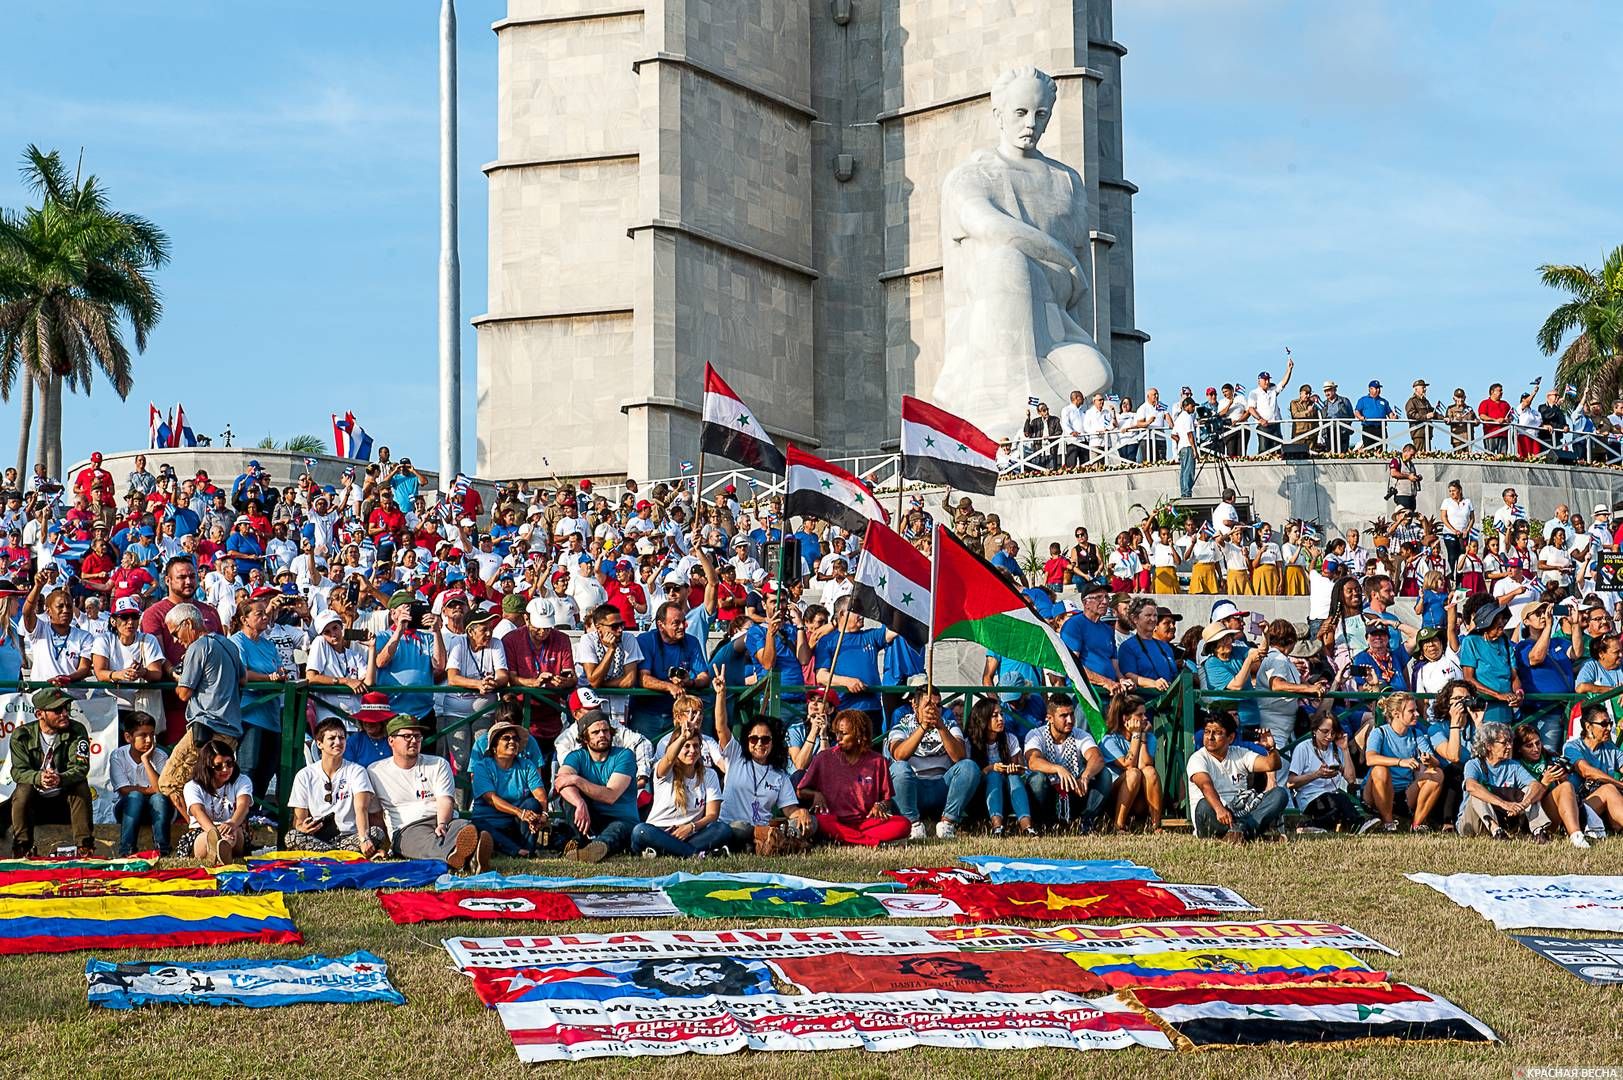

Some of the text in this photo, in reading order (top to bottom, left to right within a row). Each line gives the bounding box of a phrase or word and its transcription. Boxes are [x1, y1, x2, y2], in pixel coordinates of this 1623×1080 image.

[459, 930, 885, 949] LULA LIVRE
[922, 998, 977, 1006] War
[1052, 1009, 1104, 1022] Cuba
[981, 1030, 1008, 1039] los
